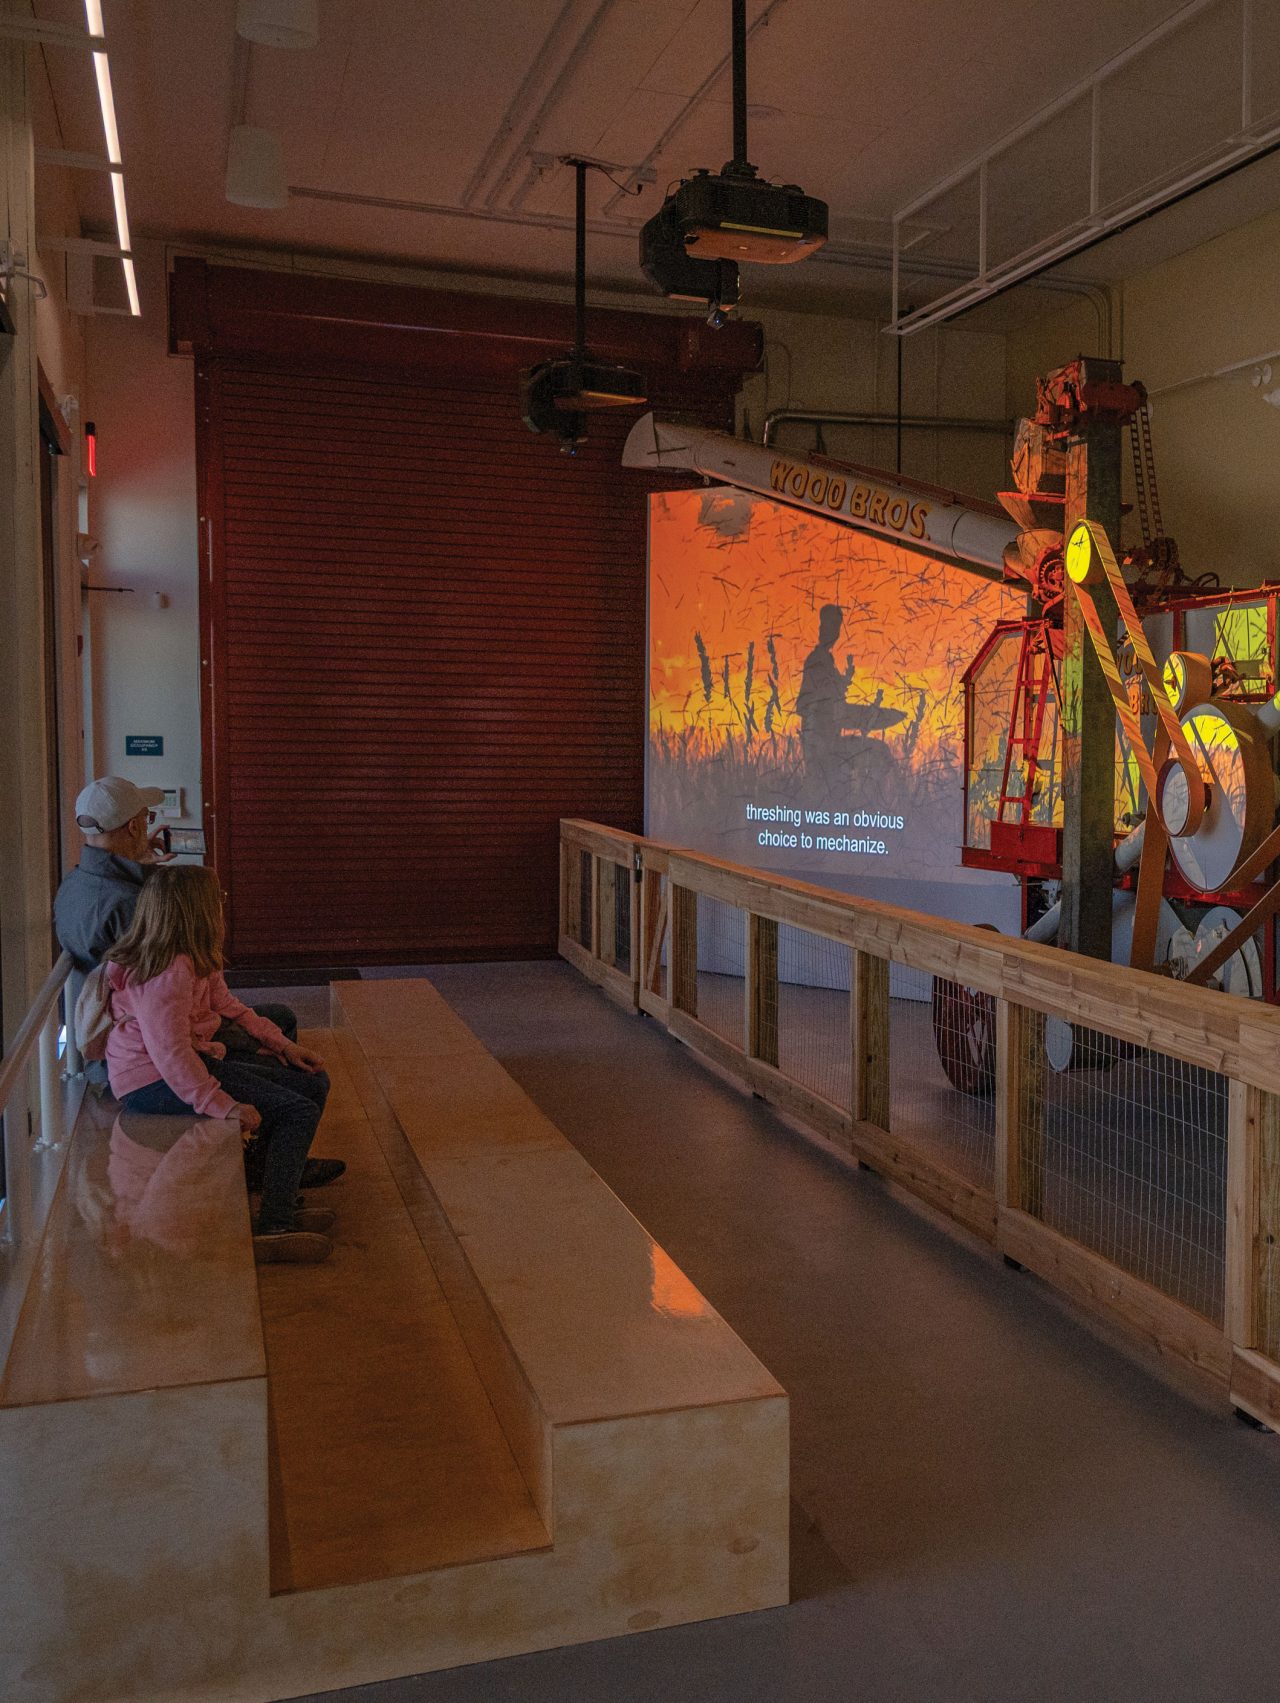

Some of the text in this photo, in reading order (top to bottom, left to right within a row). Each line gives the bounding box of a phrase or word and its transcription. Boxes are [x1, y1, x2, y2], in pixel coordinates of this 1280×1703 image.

[769, 459, 933, 541] WOOD BROS.
[745, 803, 904, 830] threshing was an obvious
[758, 829, 889, 855] choice to mechanize.
